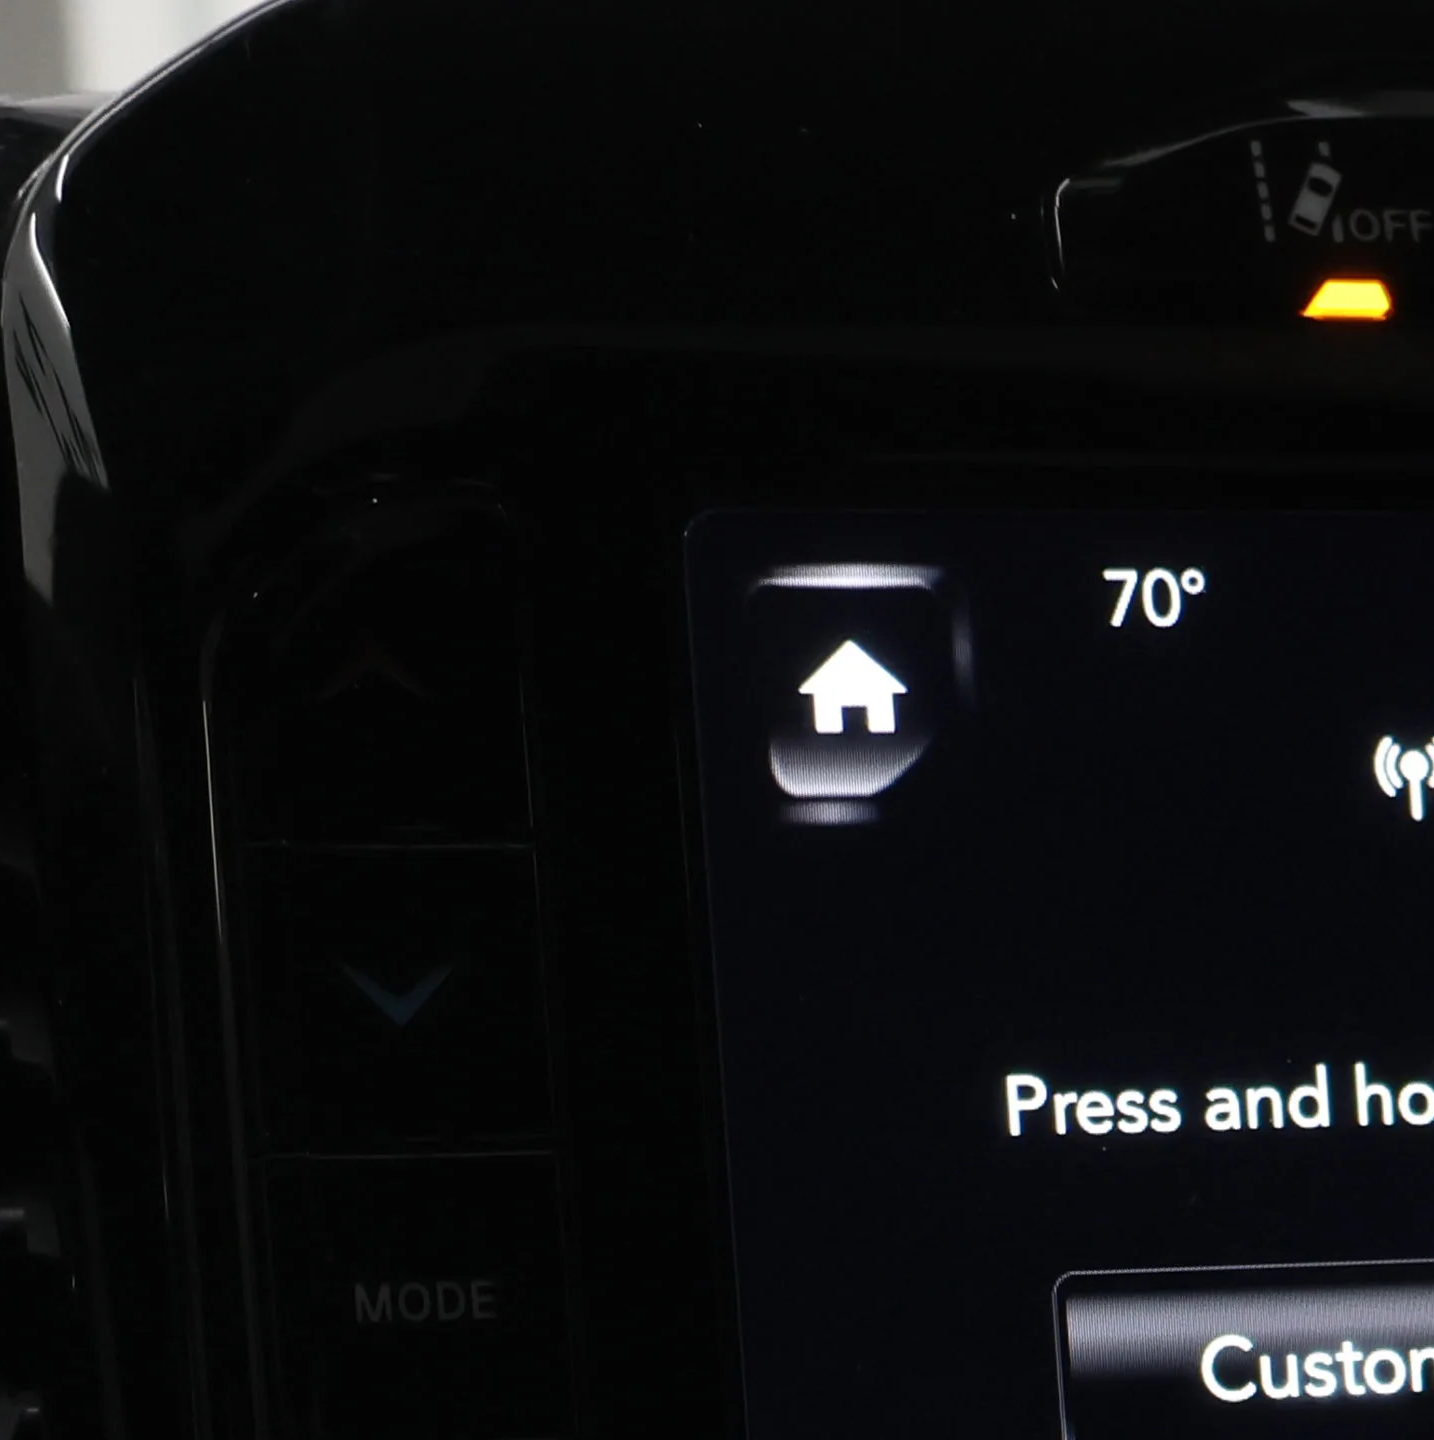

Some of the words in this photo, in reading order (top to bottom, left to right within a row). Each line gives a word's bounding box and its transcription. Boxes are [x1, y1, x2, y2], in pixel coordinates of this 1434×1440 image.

[1352, 207, 1434, 243] OFF
[1102, 567, 1206, 628] 70°
[1005, 1073, 1183, 1137] Press
[1204, 1062, 1331, 1131] and
[353, 1279, 498, 1324] MODE
